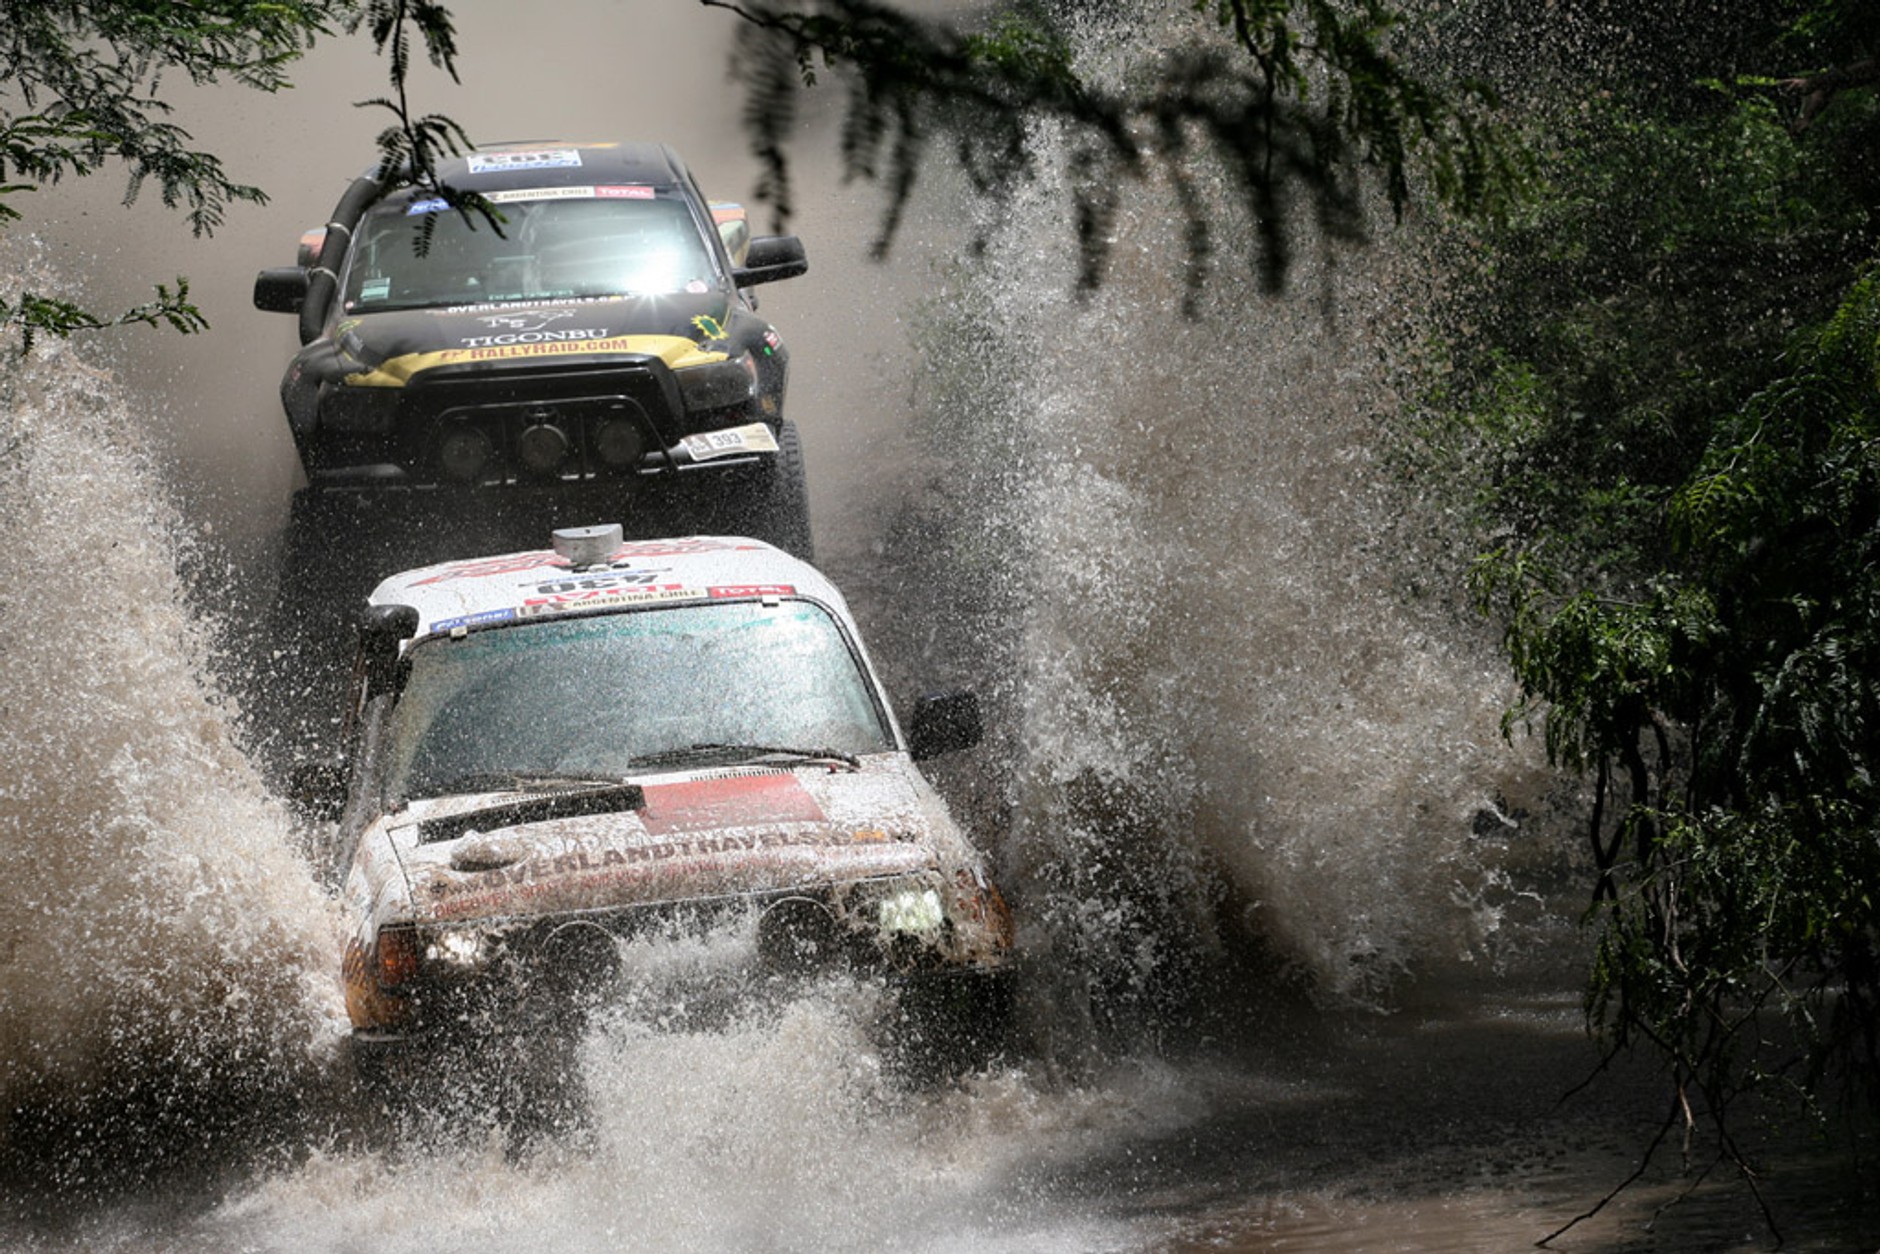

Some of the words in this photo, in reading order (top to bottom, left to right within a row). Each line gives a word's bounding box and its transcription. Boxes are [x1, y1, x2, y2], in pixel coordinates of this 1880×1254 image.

[599, 187, 651, 197] TOTAL
[461, 328, 609, 348] TIGONBU
[470, 339, 628, 360] RALLYRAID.COM
[711, 431, 743, 447] 393
[719, 586, 791, 597] TOTAL
